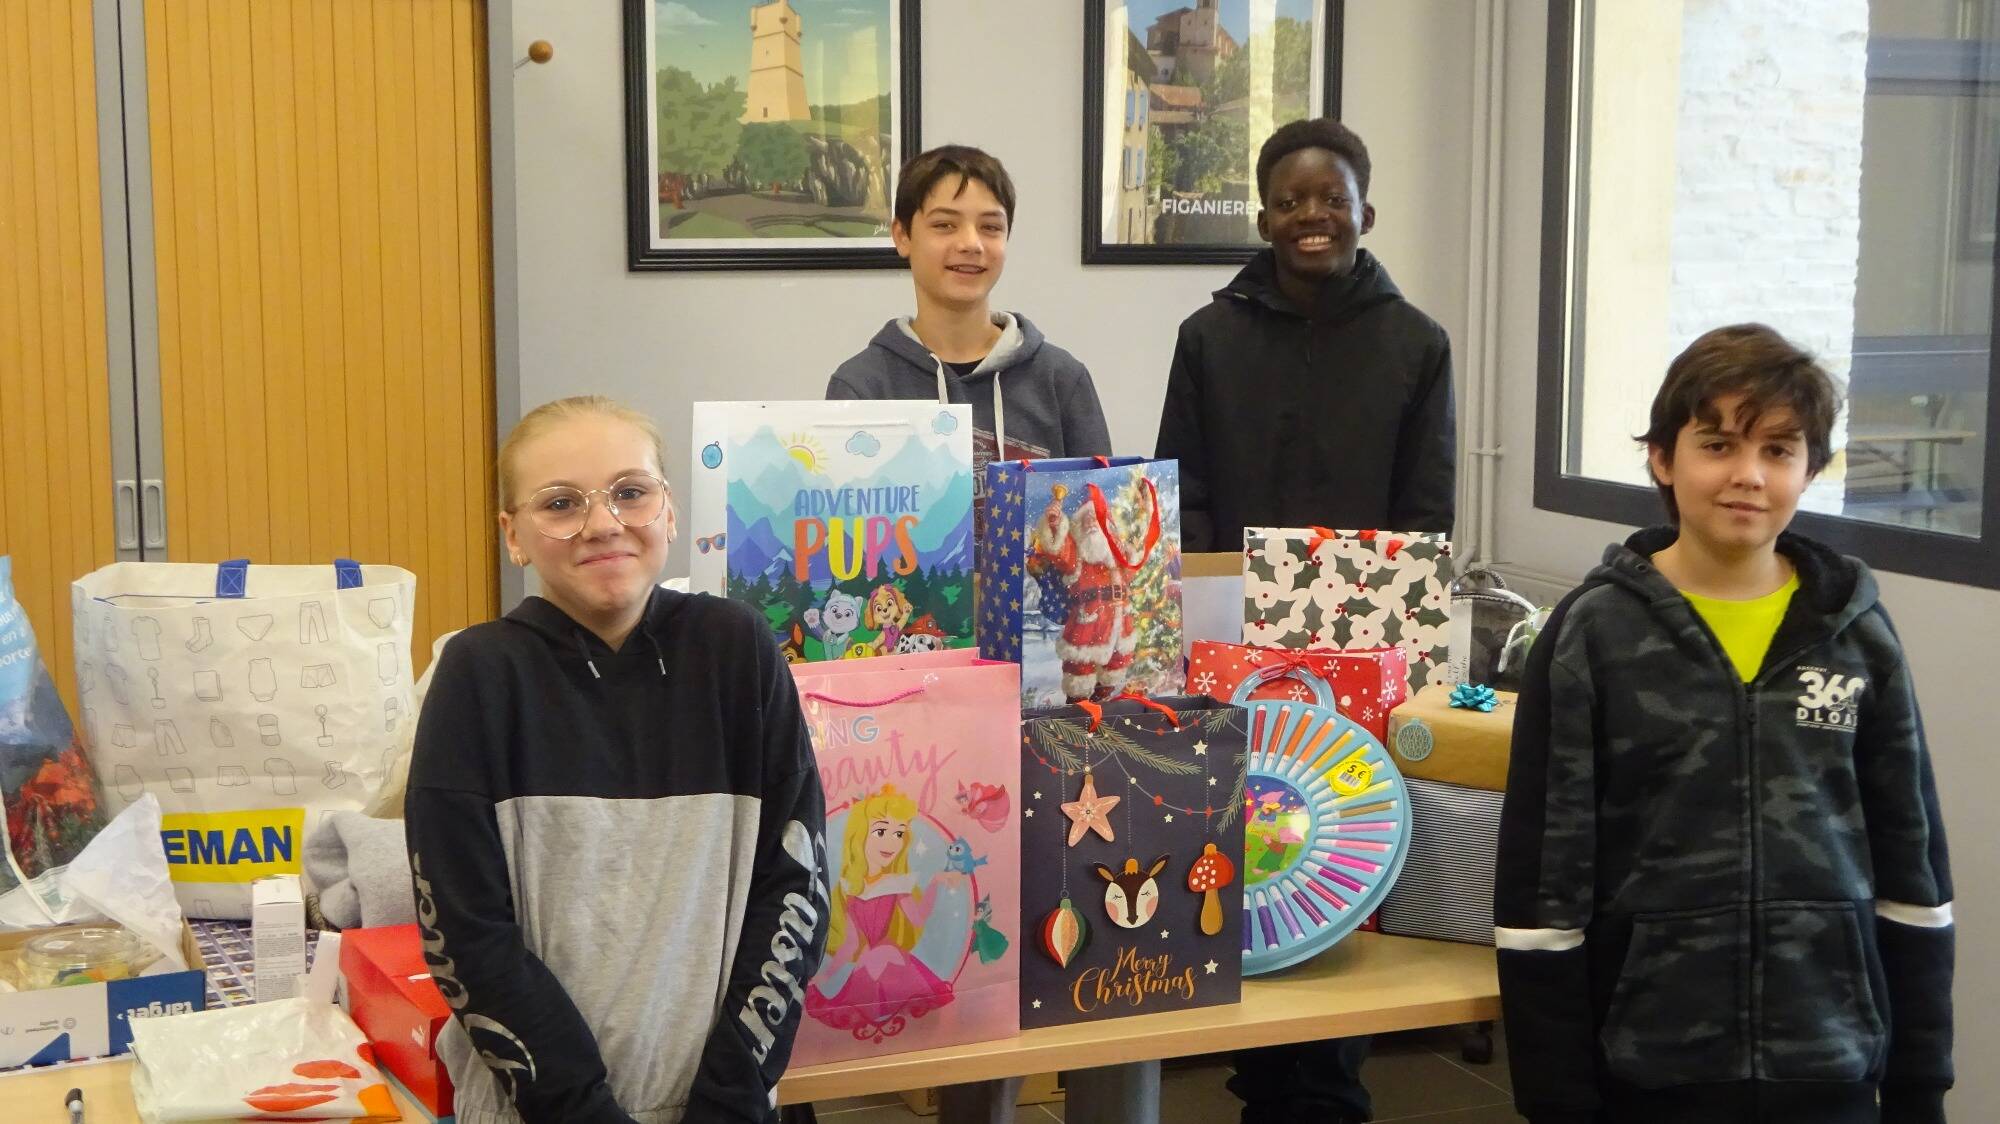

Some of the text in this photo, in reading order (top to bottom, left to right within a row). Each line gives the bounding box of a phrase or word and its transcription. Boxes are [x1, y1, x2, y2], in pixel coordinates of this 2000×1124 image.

[794, 485, 920, 517] ADVENTURE
[793, 514, 919, 583] PUPS
[1110, 945, 1173, 983] Merry
[1068, 966, 1198, 1013] Christmas
